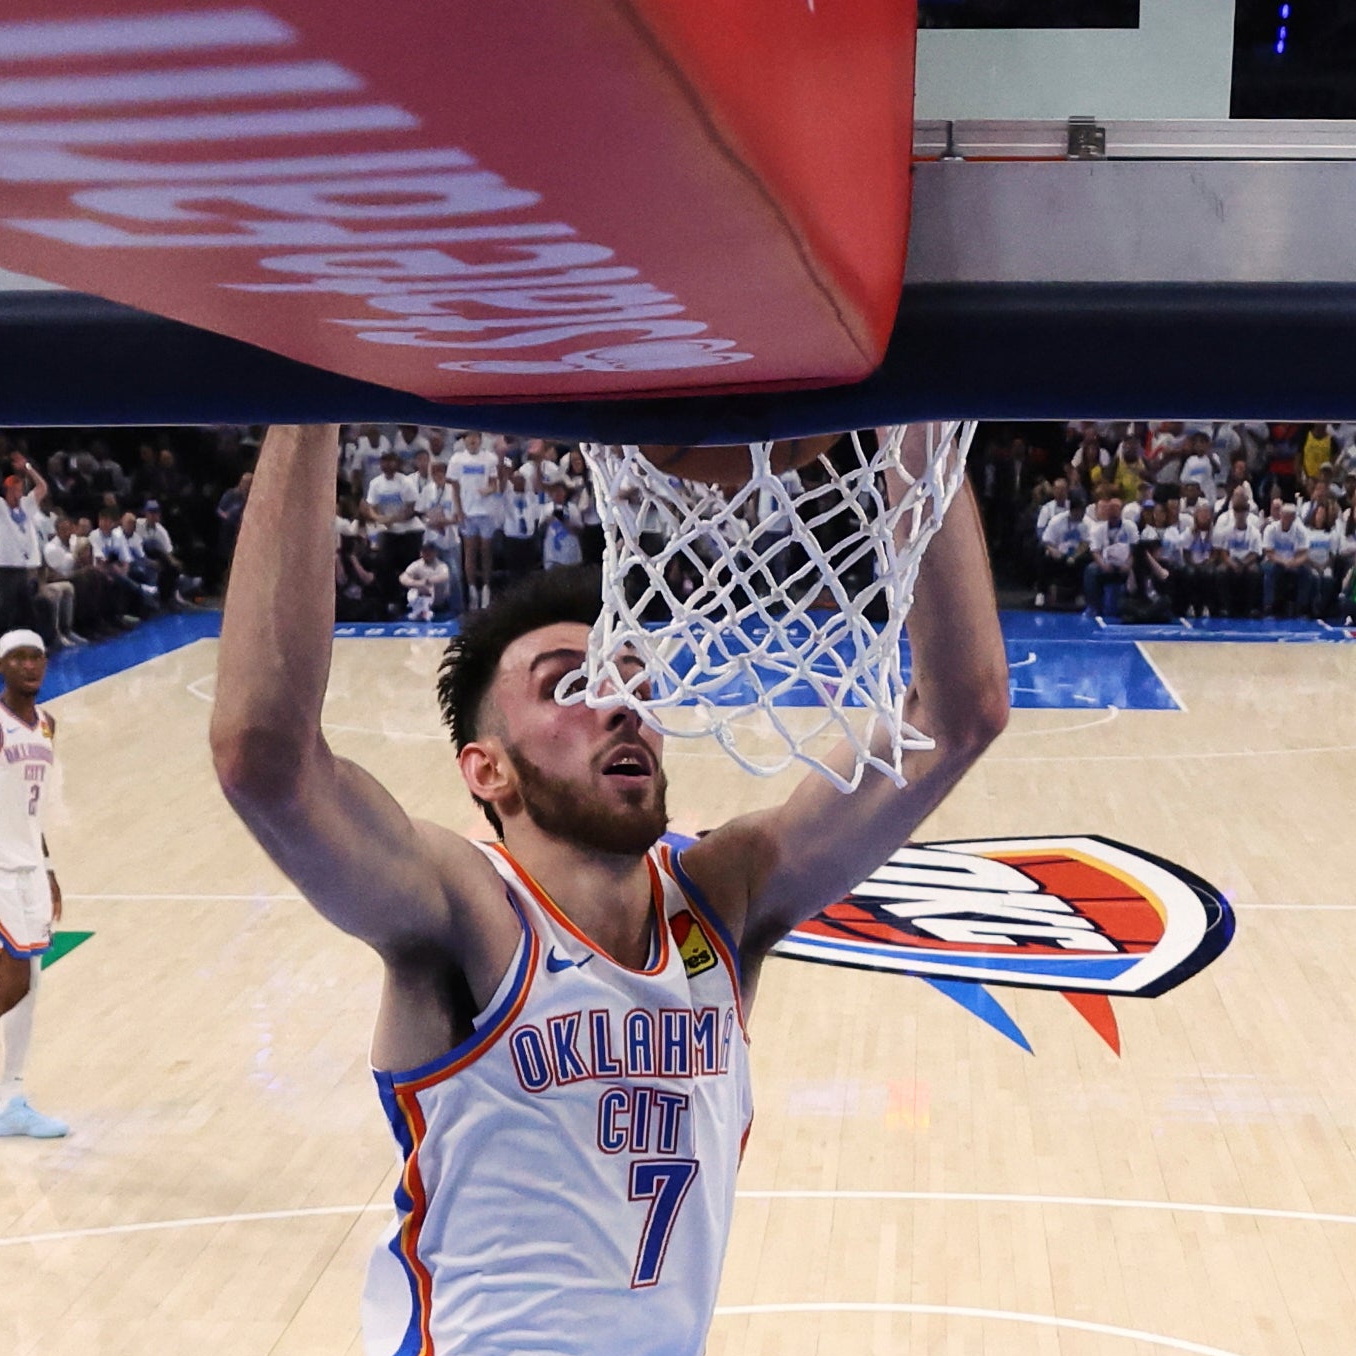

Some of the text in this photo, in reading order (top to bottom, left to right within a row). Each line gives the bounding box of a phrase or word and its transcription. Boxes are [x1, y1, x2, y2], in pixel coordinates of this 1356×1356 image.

[220, 242, 708, 349] State
[596, 1086, 698, 1156] CIT
[627, 1159, 700, 1290] 7
